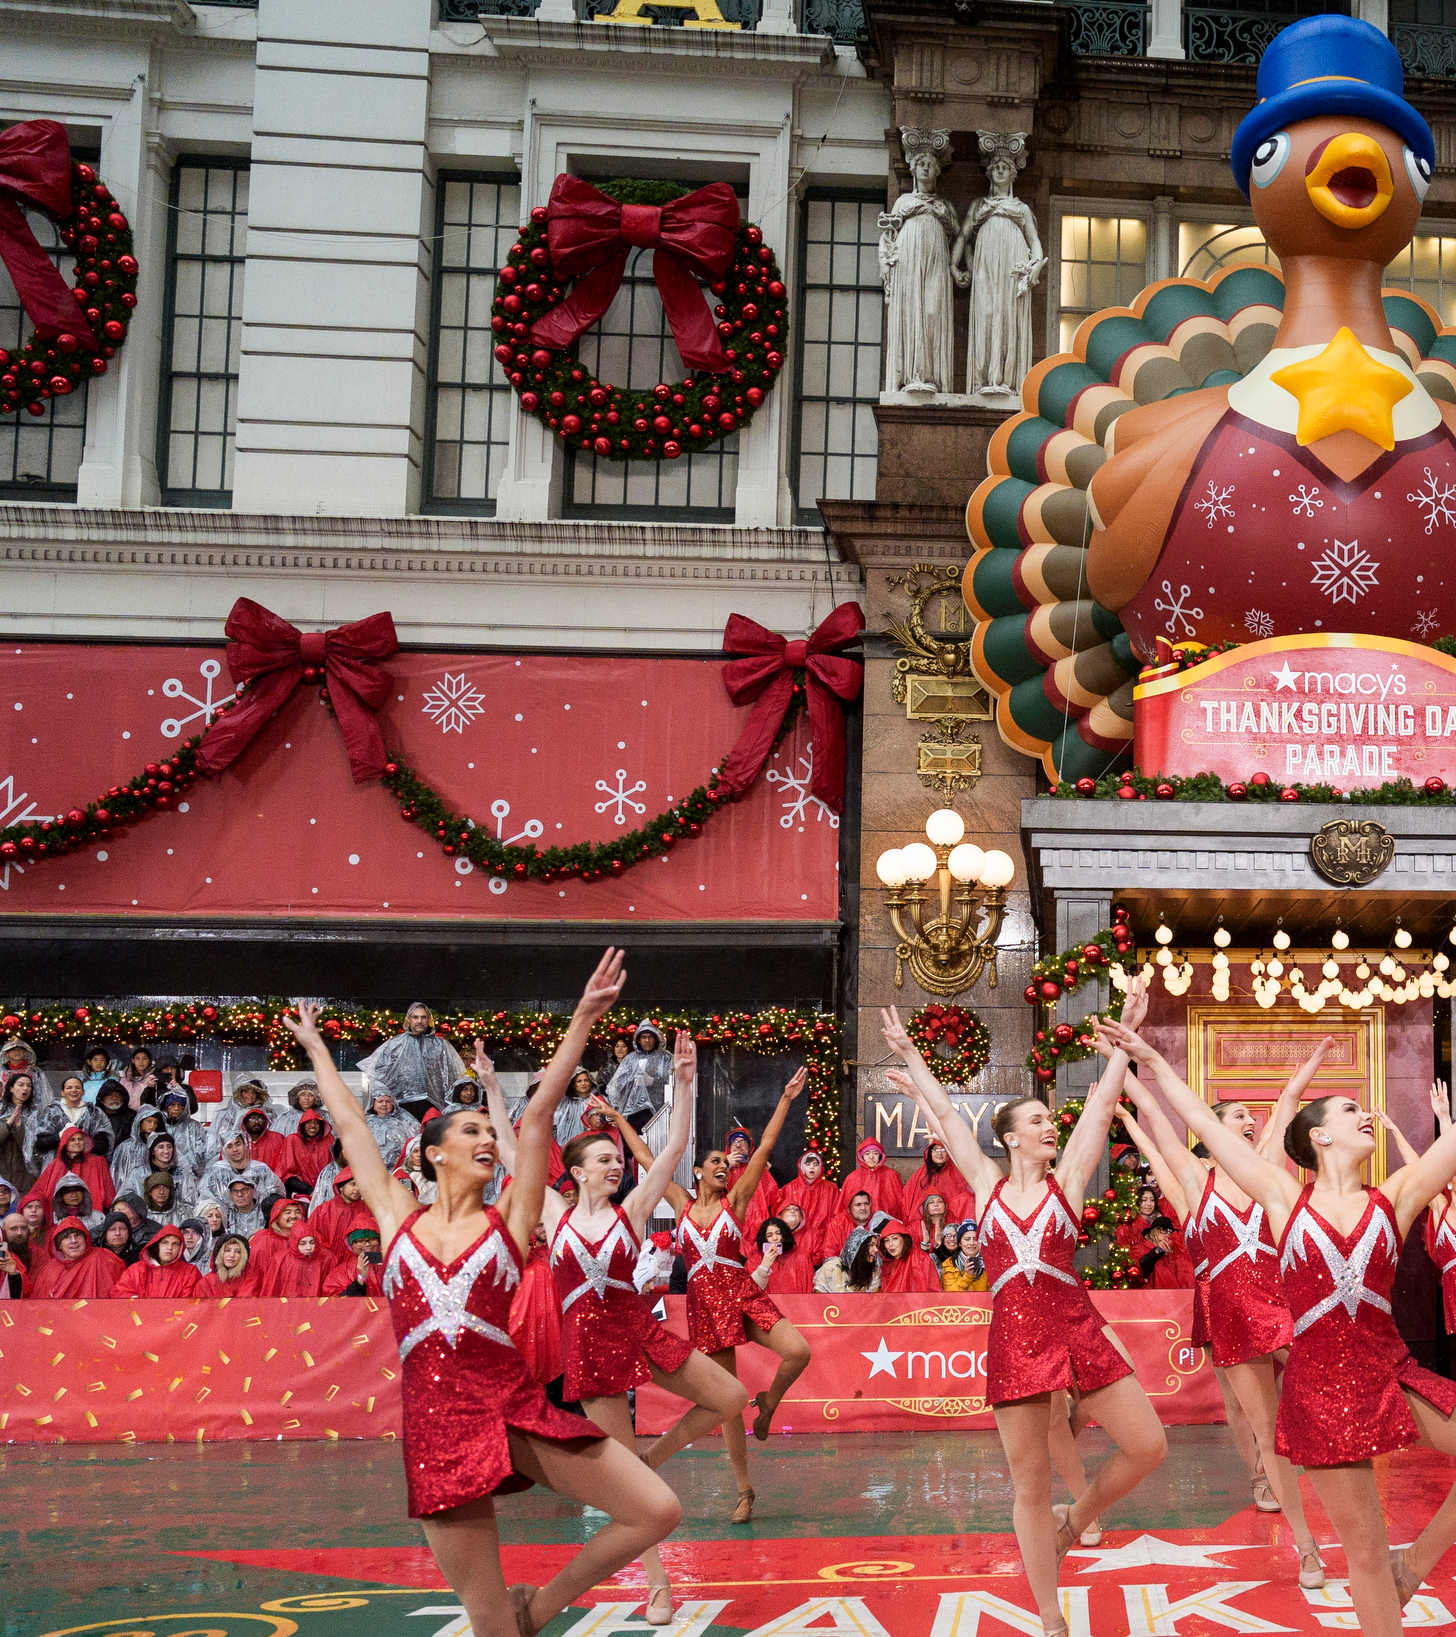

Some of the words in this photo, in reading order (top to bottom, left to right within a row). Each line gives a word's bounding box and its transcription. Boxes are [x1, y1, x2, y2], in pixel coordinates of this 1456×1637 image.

[1304, 663, 1406, 701] macy's
[1200, 701, 1415, 737] THANKSGIVING
[1286, 744, 1398, 777] PARADE
[907, 1350, 988, 1379] mac
